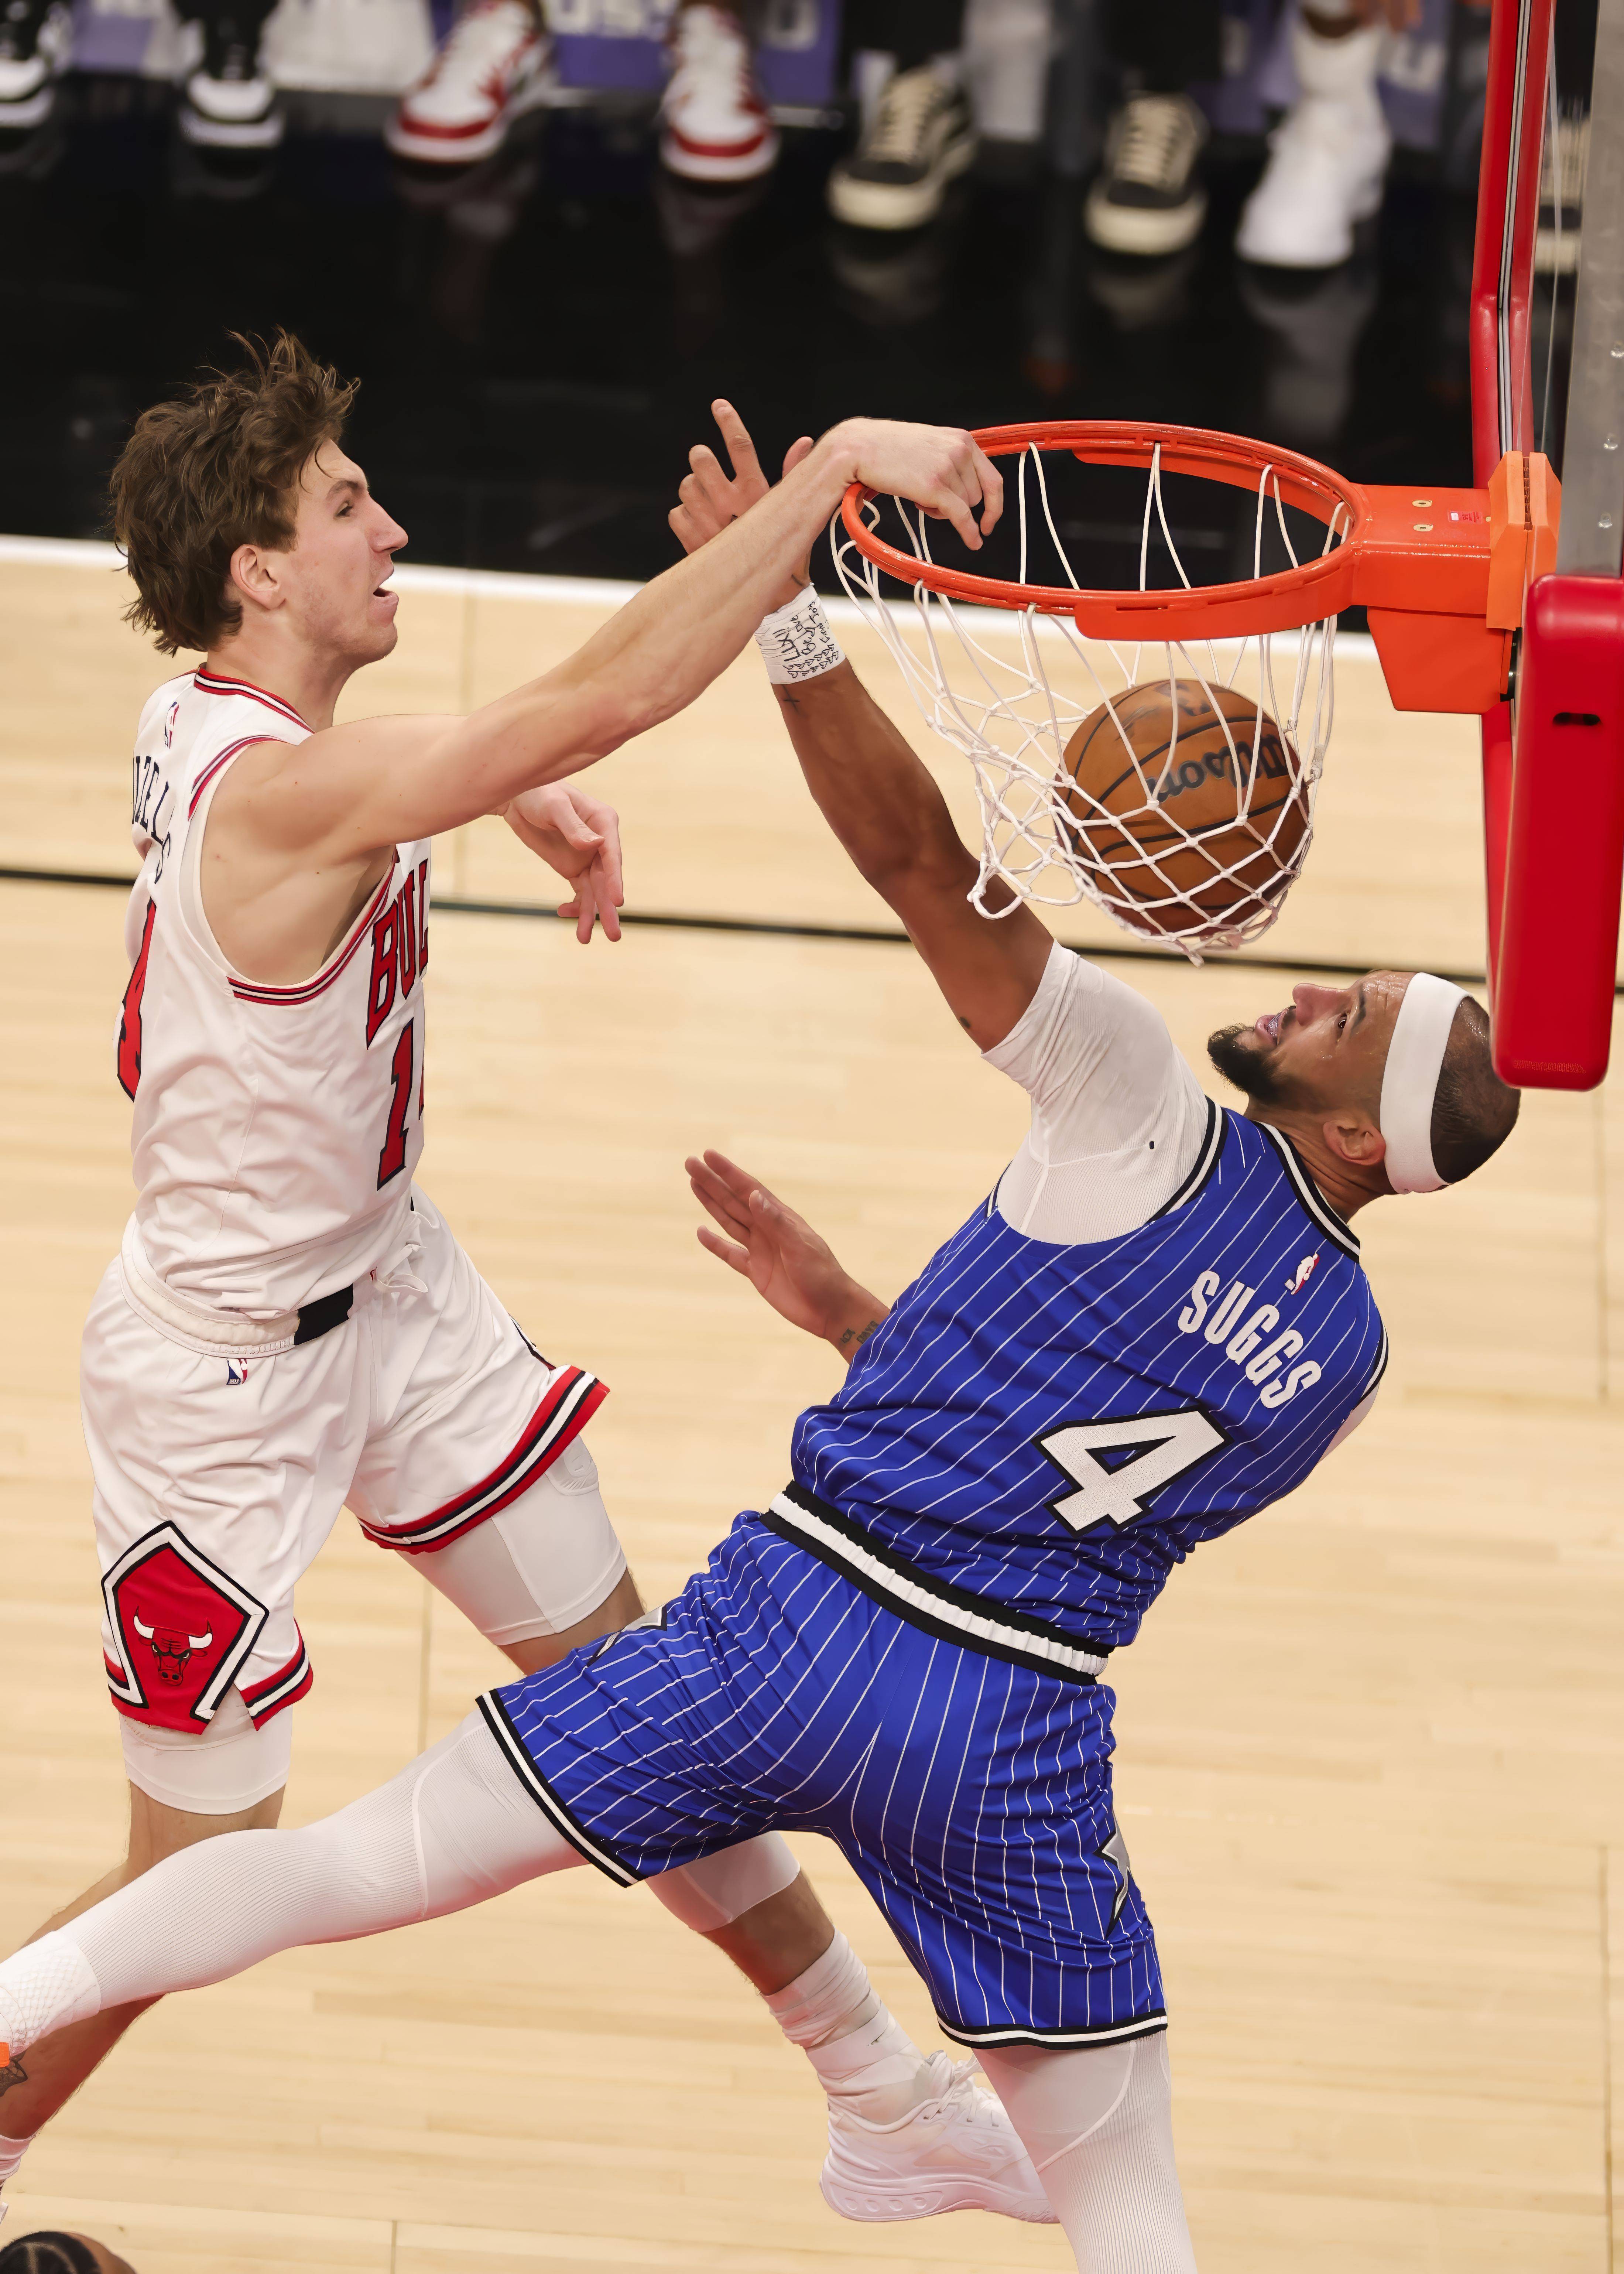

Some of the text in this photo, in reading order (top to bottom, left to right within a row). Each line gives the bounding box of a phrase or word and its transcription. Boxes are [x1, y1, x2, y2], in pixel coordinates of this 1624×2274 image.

[377, 1016, 425, 1191] 1
[1178, 1270, 1322, 1409] SUGGS
[1030, 1406, 1234, 1538] 4
